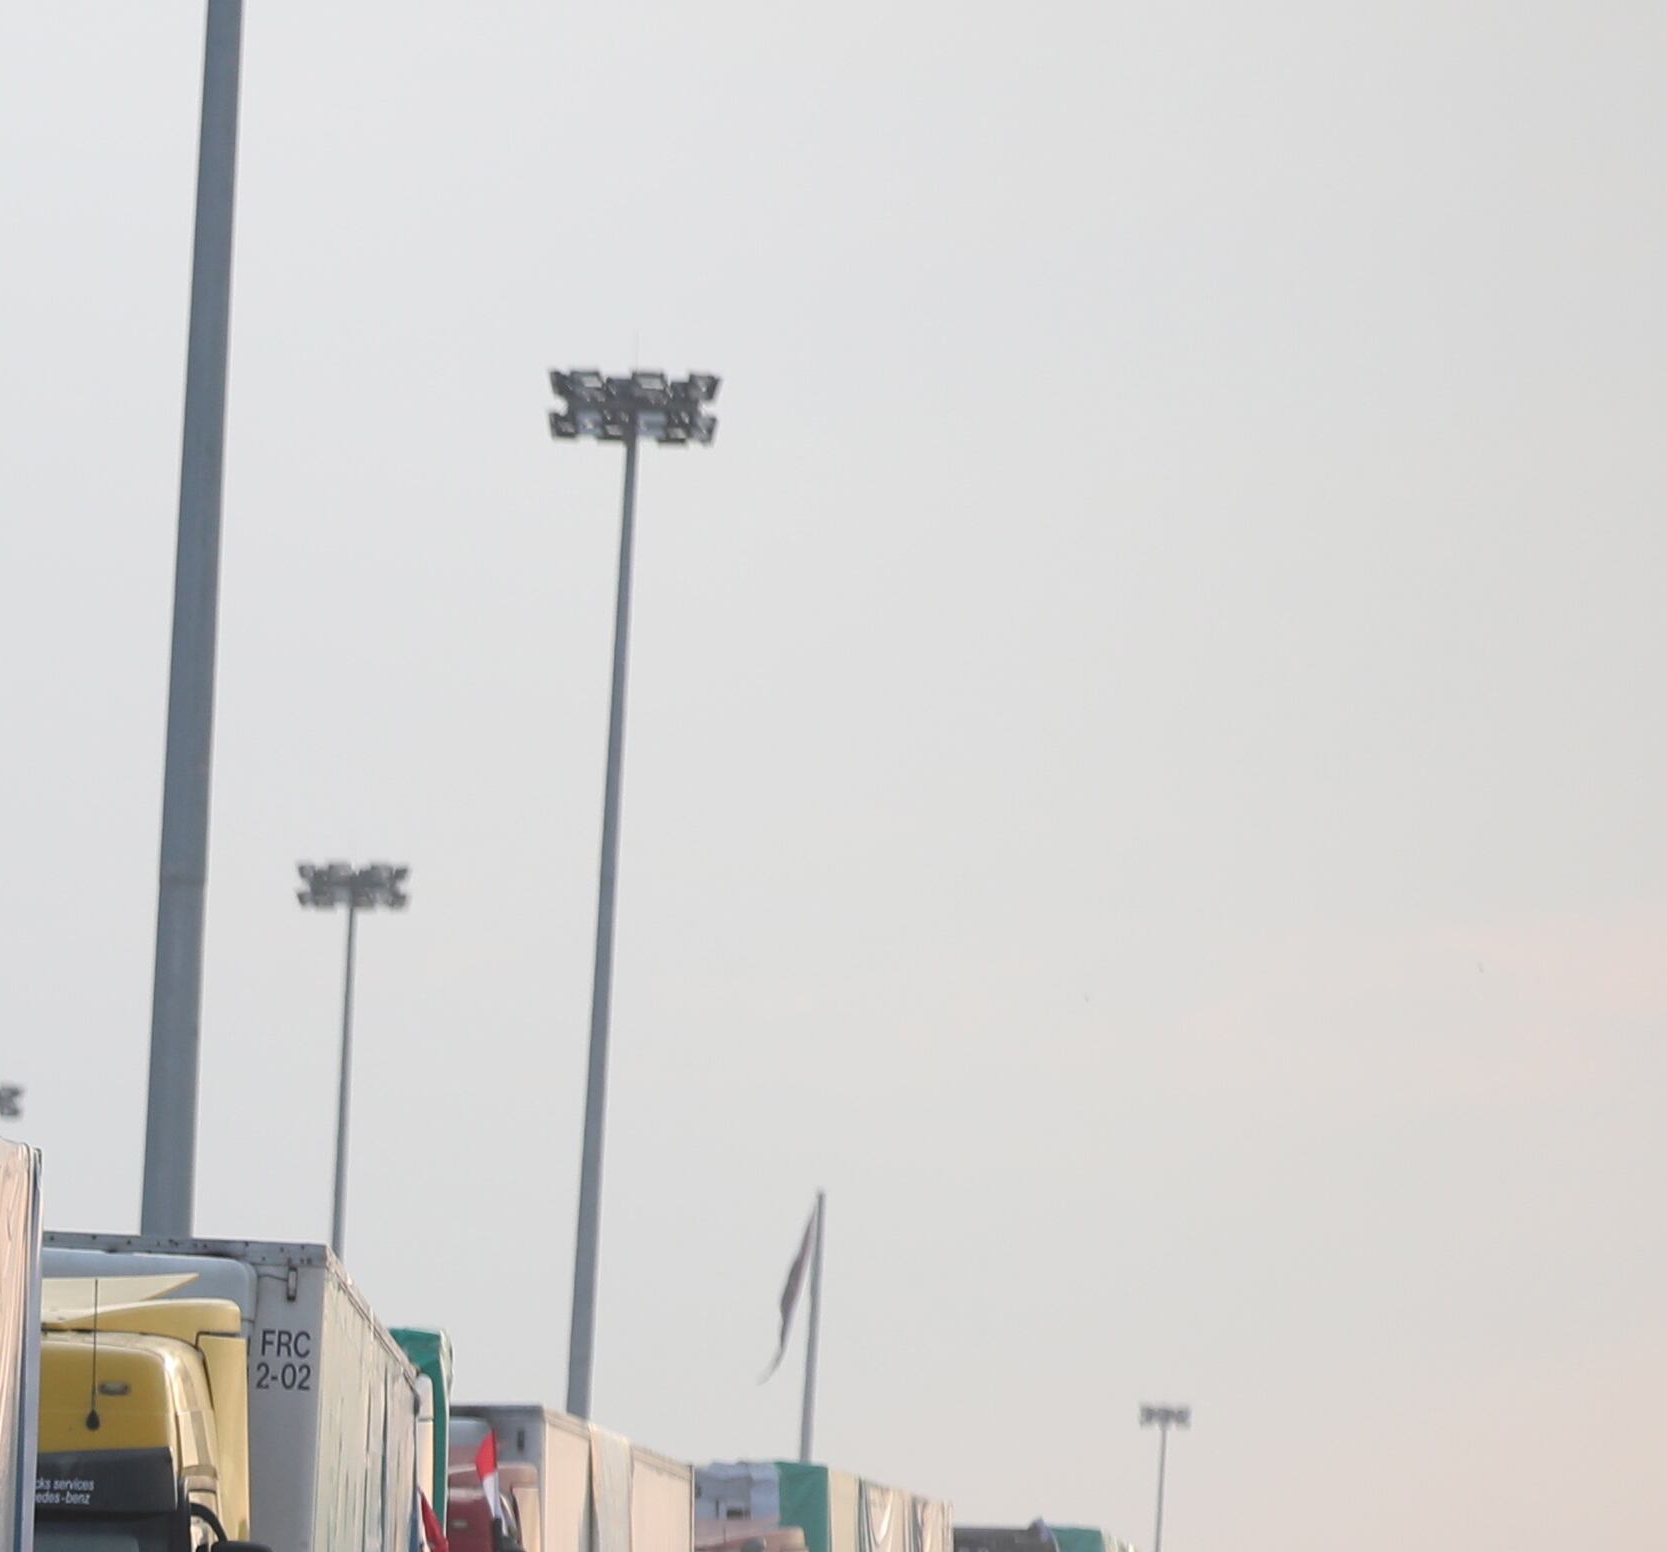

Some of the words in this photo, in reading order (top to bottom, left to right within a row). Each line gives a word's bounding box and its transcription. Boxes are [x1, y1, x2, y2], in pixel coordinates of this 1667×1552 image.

[261, 1328, 312, 1359] FRC
[255, 1361, 312, 1391] 2-02
[53, 1478, 96, 1492] services
